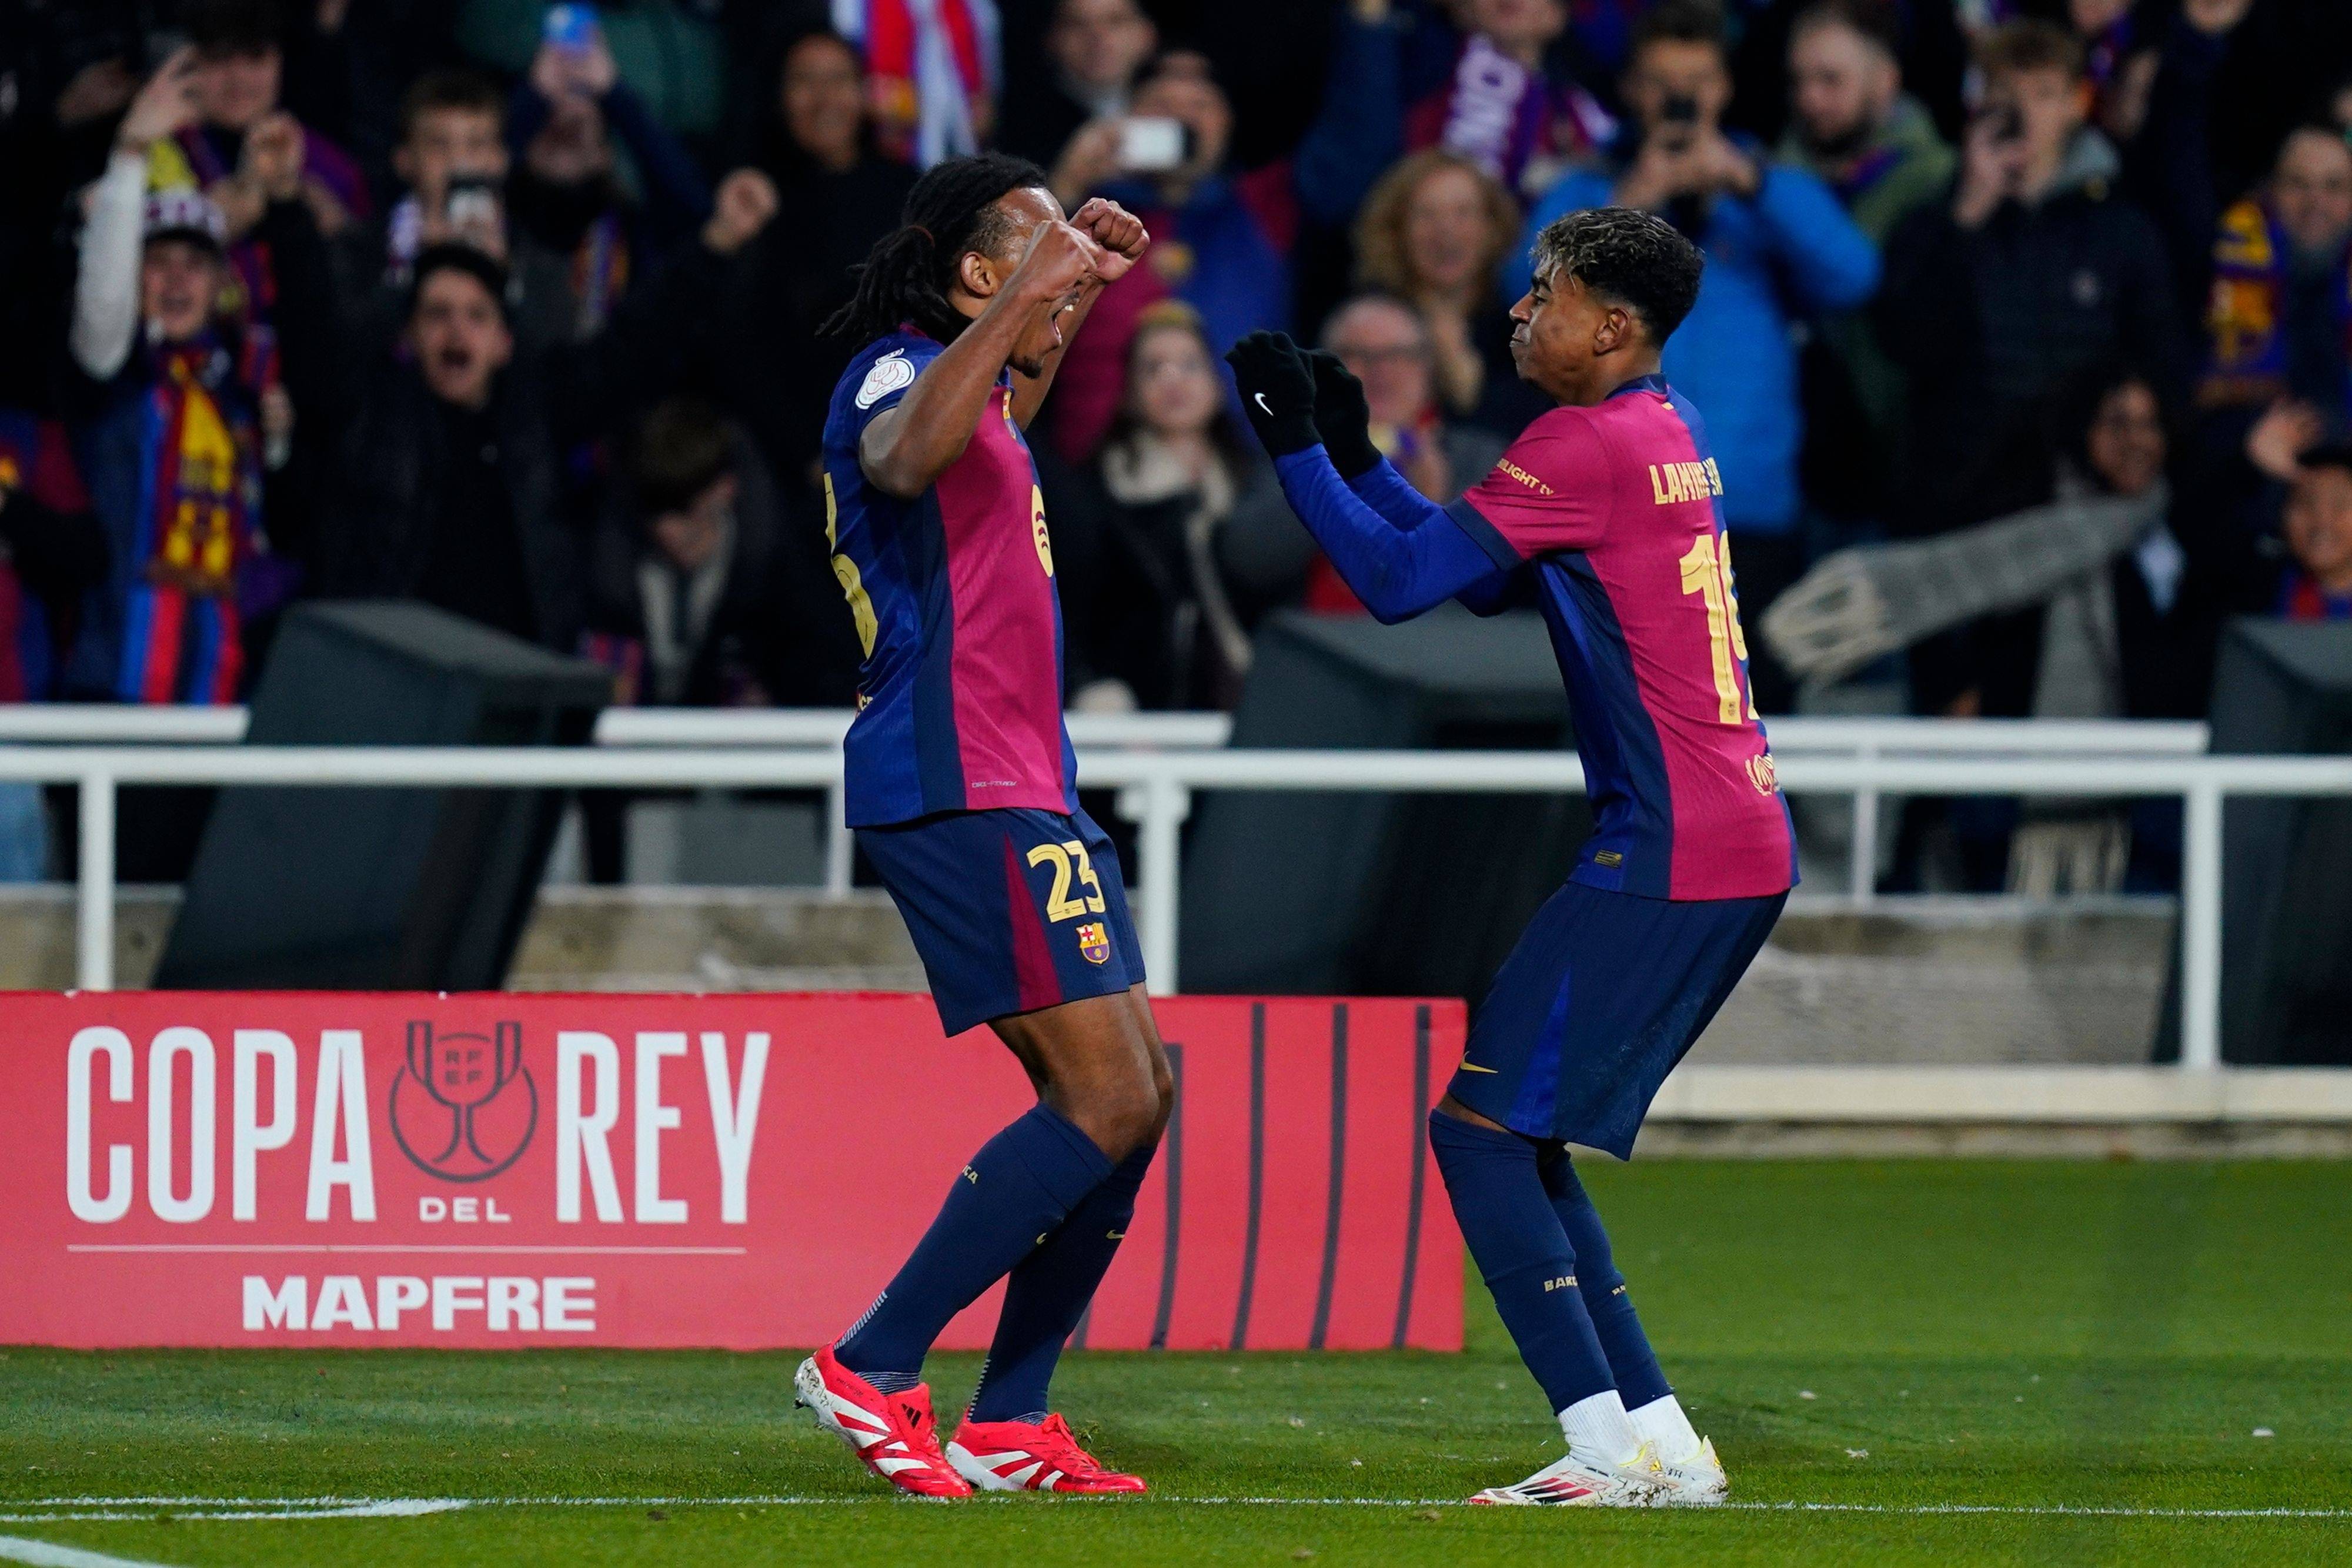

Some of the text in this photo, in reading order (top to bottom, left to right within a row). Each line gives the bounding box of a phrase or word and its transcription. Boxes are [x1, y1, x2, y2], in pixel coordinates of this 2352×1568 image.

[1026, 840, 1106, 923] 23
[66, 1026, 771, 1224] COPA DEL REY
[242, 1275, 596, 1332] MAPFRE
